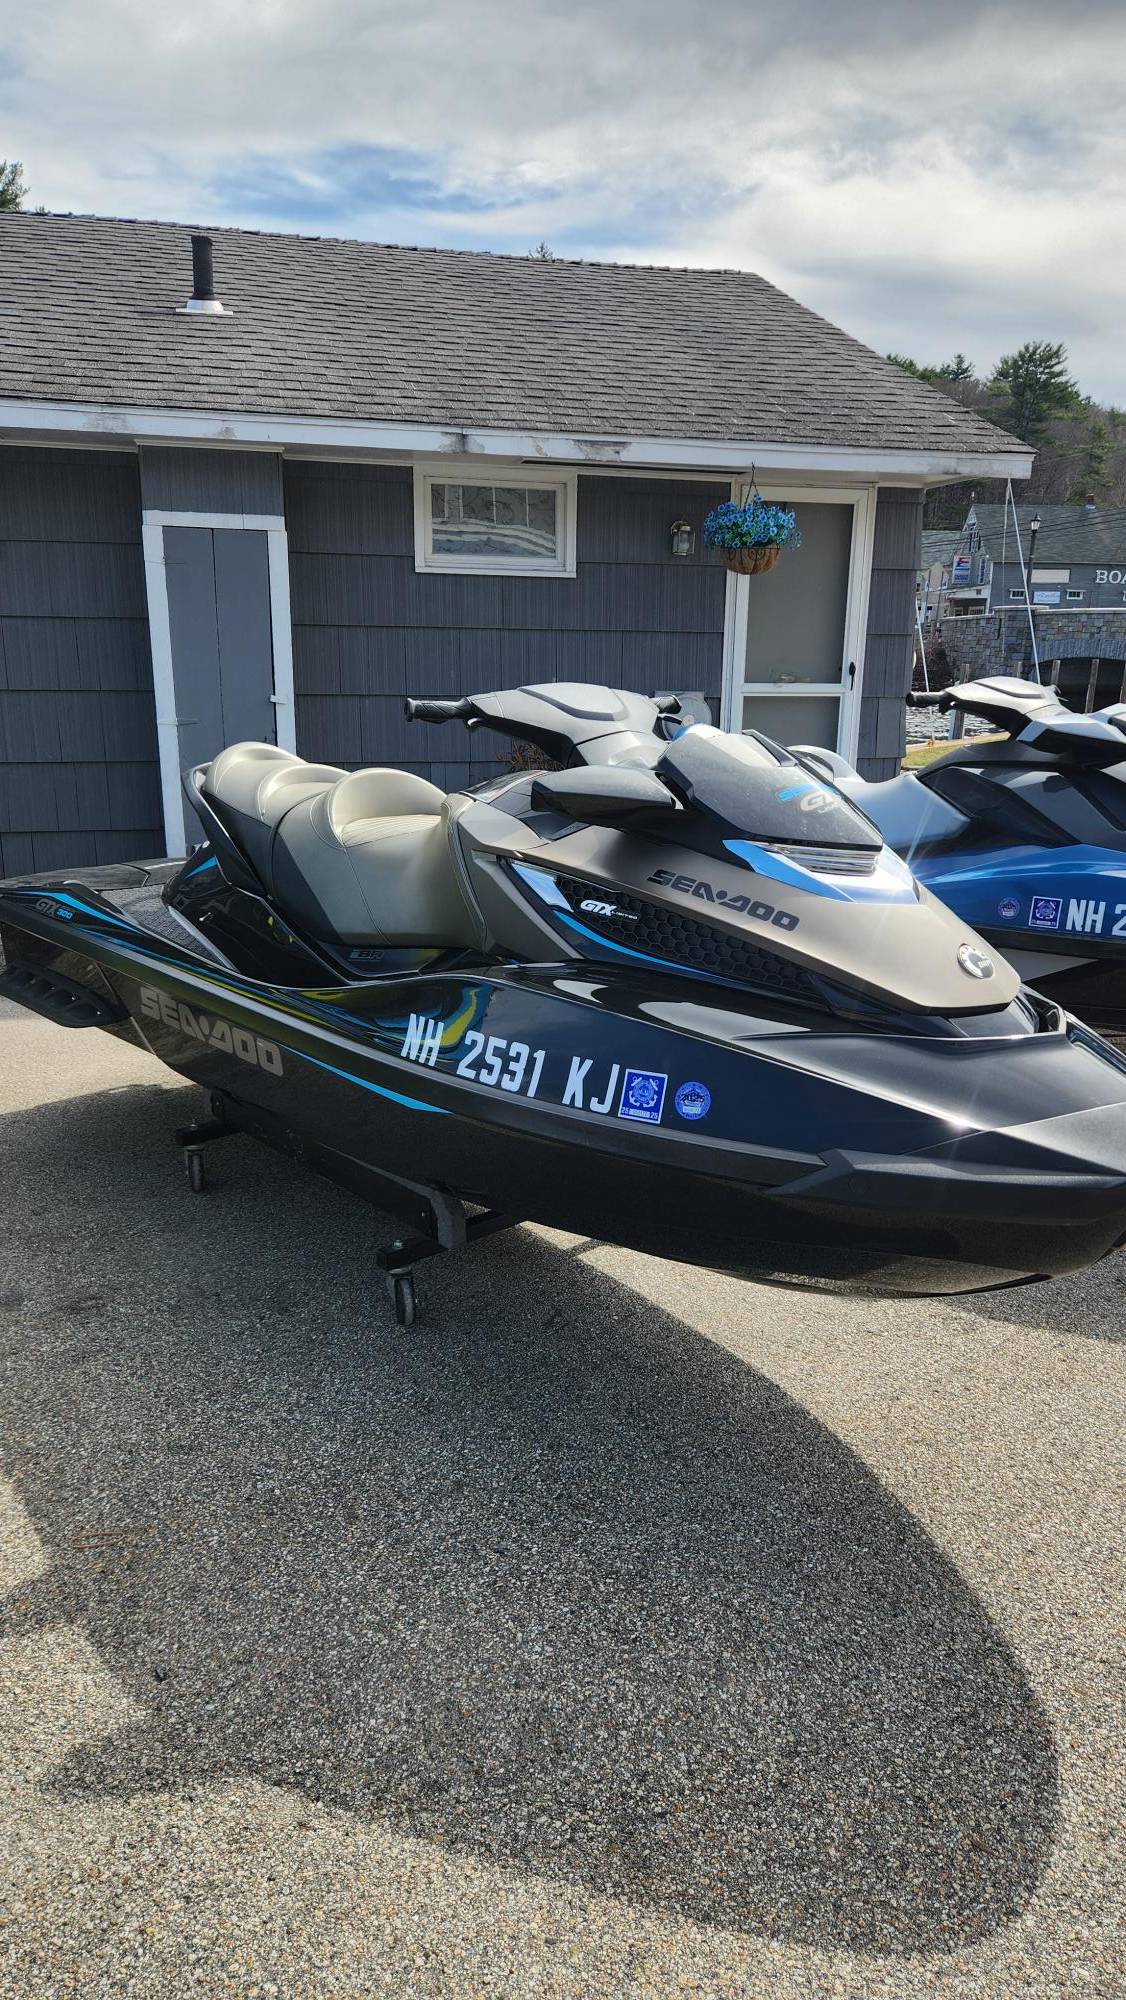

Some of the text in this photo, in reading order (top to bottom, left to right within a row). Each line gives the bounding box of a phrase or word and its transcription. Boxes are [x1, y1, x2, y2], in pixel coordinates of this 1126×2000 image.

[35, 898, 62, 917] GTX
[580, 900, 617, 917] GTX
[1065, 898, 1106, 933] NH
[401, 1013, 445, 1067] NH
[456, 1030, 546, 1097] 2531
